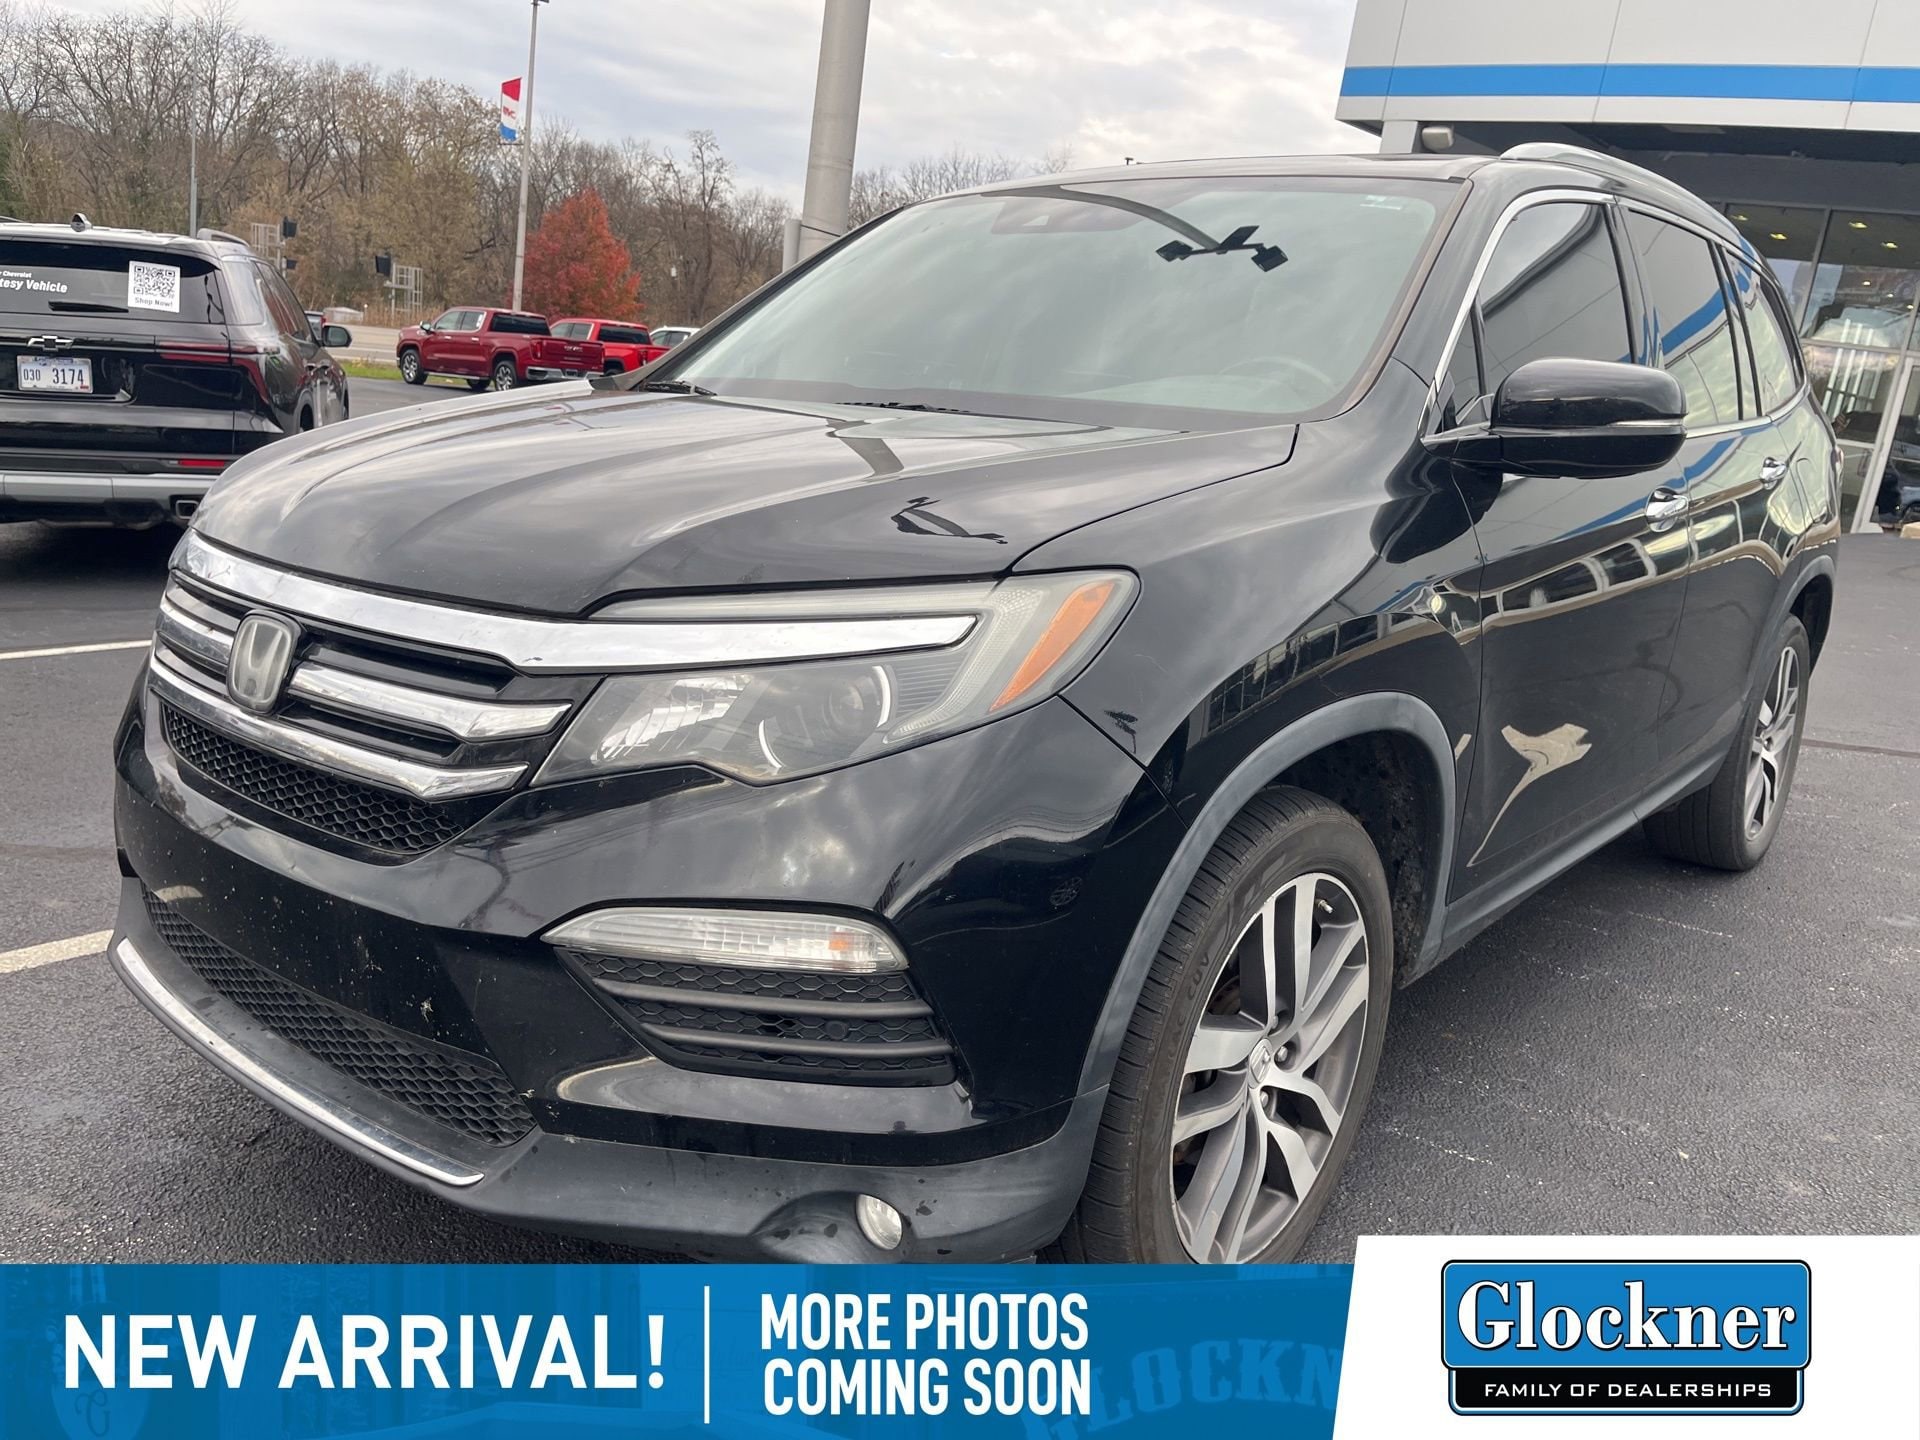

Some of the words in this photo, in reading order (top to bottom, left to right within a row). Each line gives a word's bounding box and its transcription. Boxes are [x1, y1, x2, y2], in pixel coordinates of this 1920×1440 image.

[26, 279, 68, 293] Vehicle
[134, 297, 153, 306] Shop
[154, 299, 173, 307] Now!
[23, 368, 41, 381] 030
[52, 367, 84, 385] 3174
